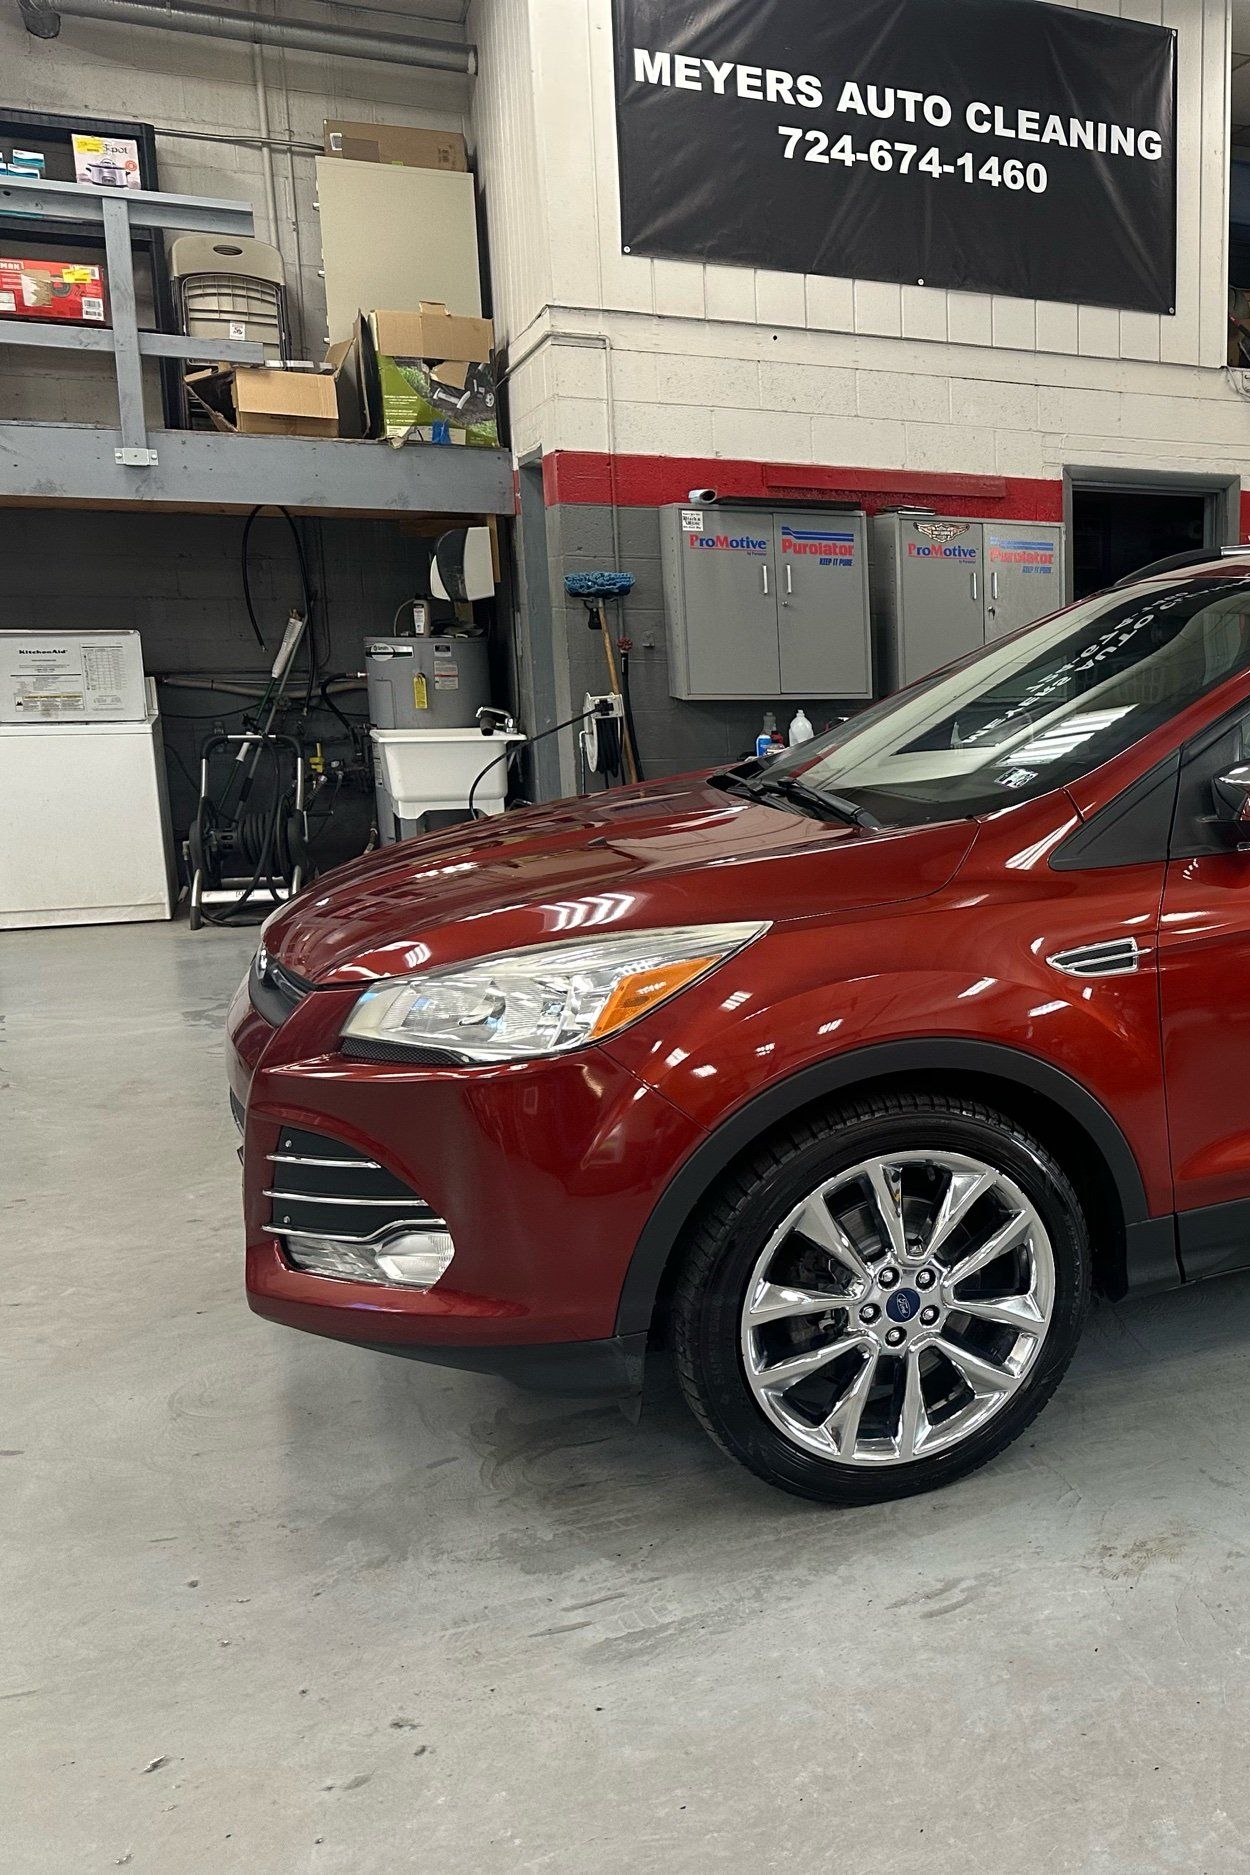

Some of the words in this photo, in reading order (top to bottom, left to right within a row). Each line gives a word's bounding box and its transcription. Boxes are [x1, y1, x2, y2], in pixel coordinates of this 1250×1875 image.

[633, 48, 823, 108] MEYERS
[836, 81, 952, 128] AUTO
[965, 102, 1163, 161] CLEANING
[777, 125, 1049, 194] 724-674-1460
[689, 533, 767, 549] ProMotive
[782, 538, 855, 556] Purolator
[908, 543, 977, 557] ProMotive
